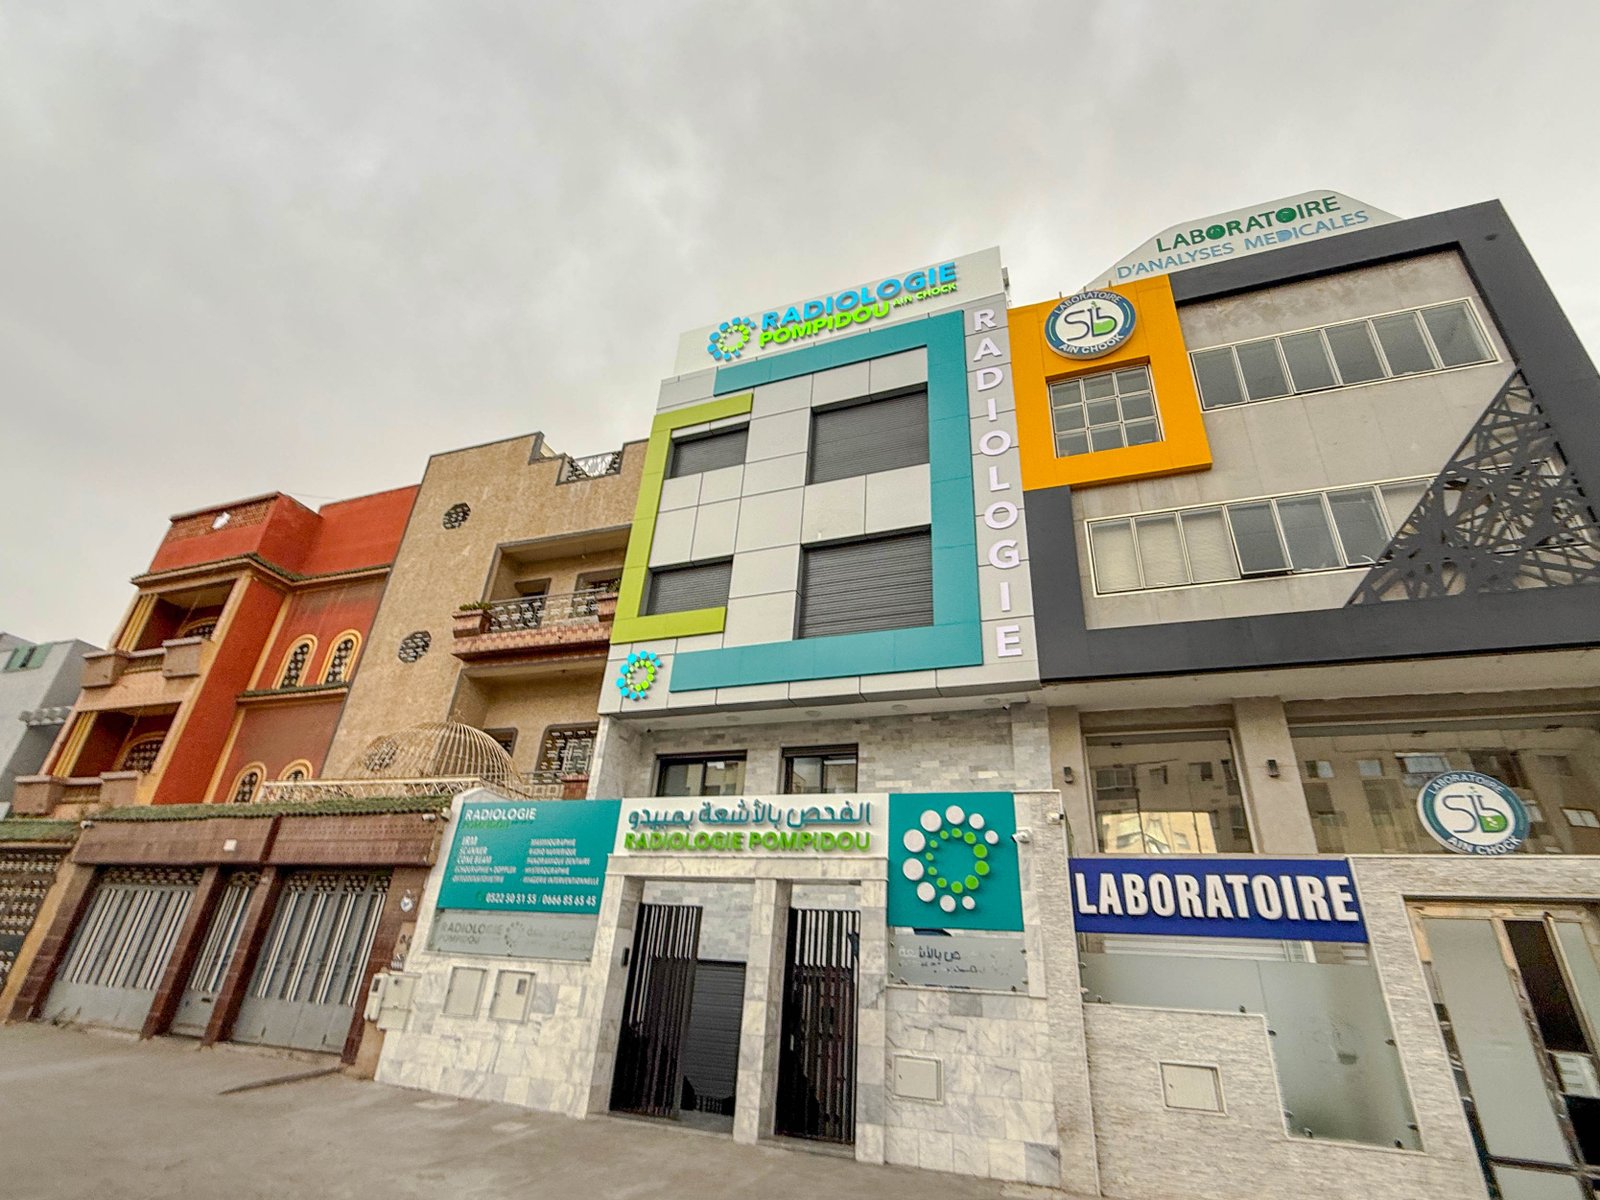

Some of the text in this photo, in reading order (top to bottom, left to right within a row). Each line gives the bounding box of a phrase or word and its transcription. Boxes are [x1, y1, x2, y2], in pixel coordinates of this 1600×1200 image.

[1156, 195, 1341, 253] LABORATOIRE
[1117, 210, 1369, 280] D'ANALYSES MEDICALES
[761, 261, 957, 330] RADIOLOGIE
[892, 282, 958, 308] AIN CHOCK
[1054, 291, 1122, 314] LABORATOIRE
[758, 302, 890, 348] POMPIDOU
[1058, 343, 1080, 354] AIN
[972, 308, 1022, 658] RADIOLOGIE
[464, 807, 537, 821] RADIOLOGIE
[699, 799, 782, 829] بالأشعة
[787, 800, 873, 829] الفحص
[624, 830, 872, 853] RADIOLOGIE POMPIDOU
[1475, 835, 1522, 856] CHOCK
[1074, 872, 1360, 922] LABORATOIRE
